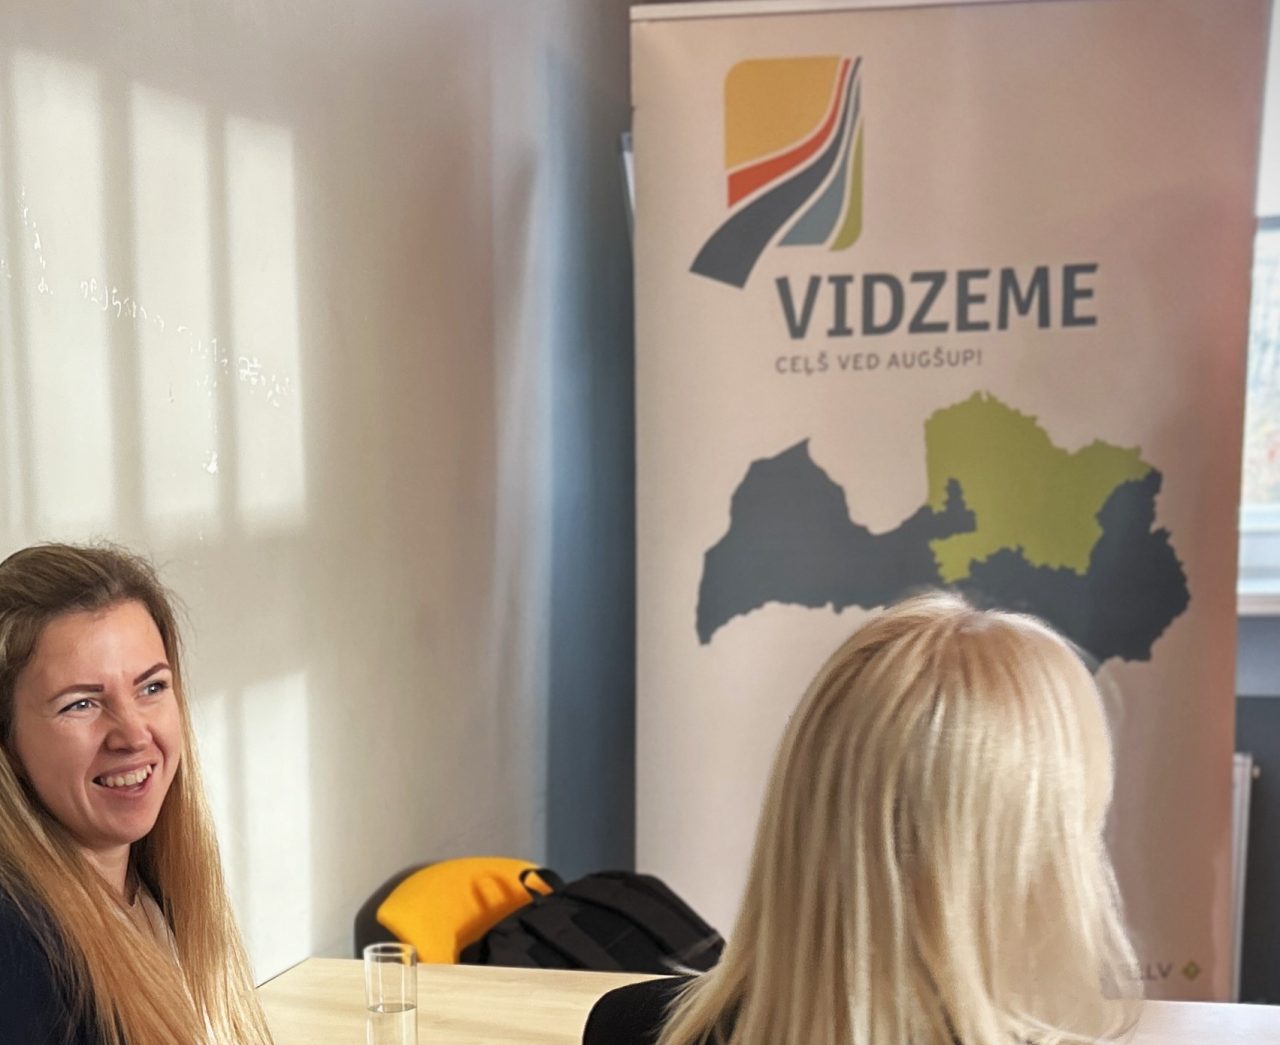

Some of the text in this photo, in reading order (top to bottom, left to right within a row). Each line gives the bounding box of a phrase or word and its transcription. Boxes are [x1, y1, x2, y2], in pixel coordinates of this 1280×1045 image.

[775, 263, 1098, 339] VIDZEME
[837, 353, 880, 371] VED
[886, 346, 983, 369] AUGŠUP!
